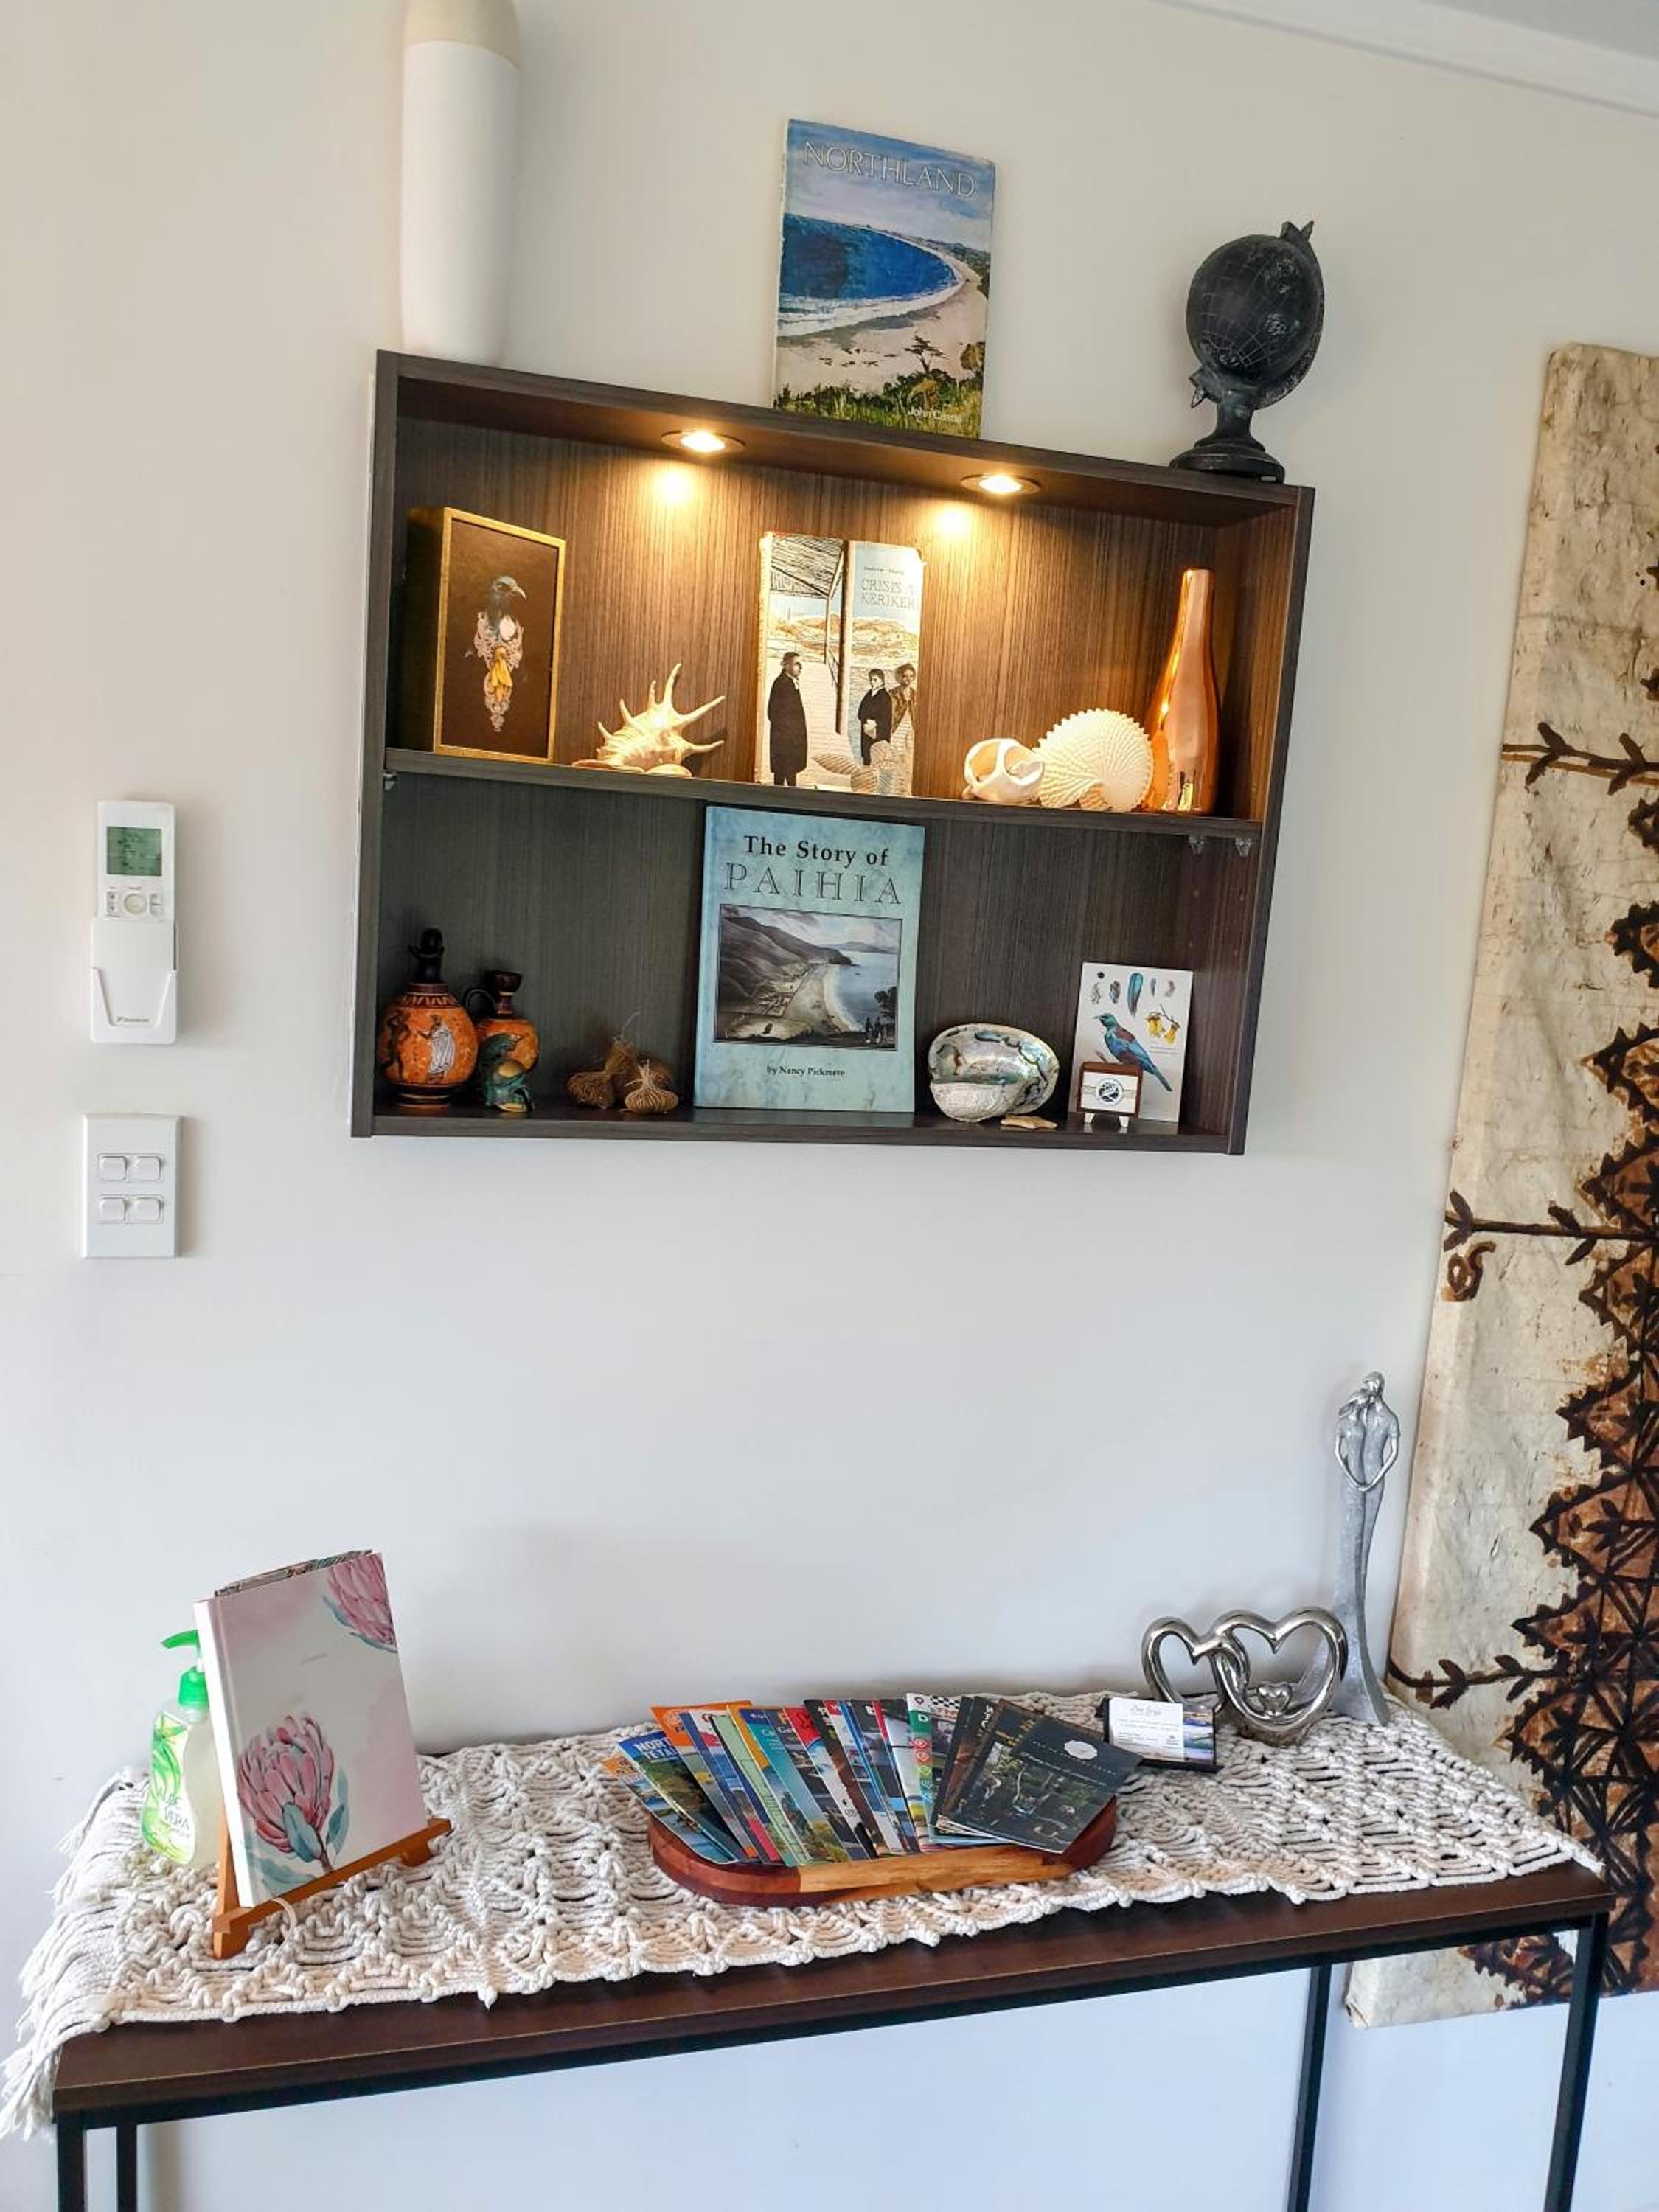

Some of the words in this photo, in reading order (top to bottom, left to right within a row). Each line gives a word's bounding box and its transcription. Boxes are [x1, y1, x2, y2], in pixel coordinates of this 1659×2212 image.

[803, 141, 977, 198] NORTHLAND
[744, 835, 786, 856] The
[796, 840, 856, 868] Story
[866, 849, 890, 866] of
[723, 861, 902, 905] PAIHIA
[767, 1066, 777, 1076] by
[779, 1066, 805, 1077] Nancy
